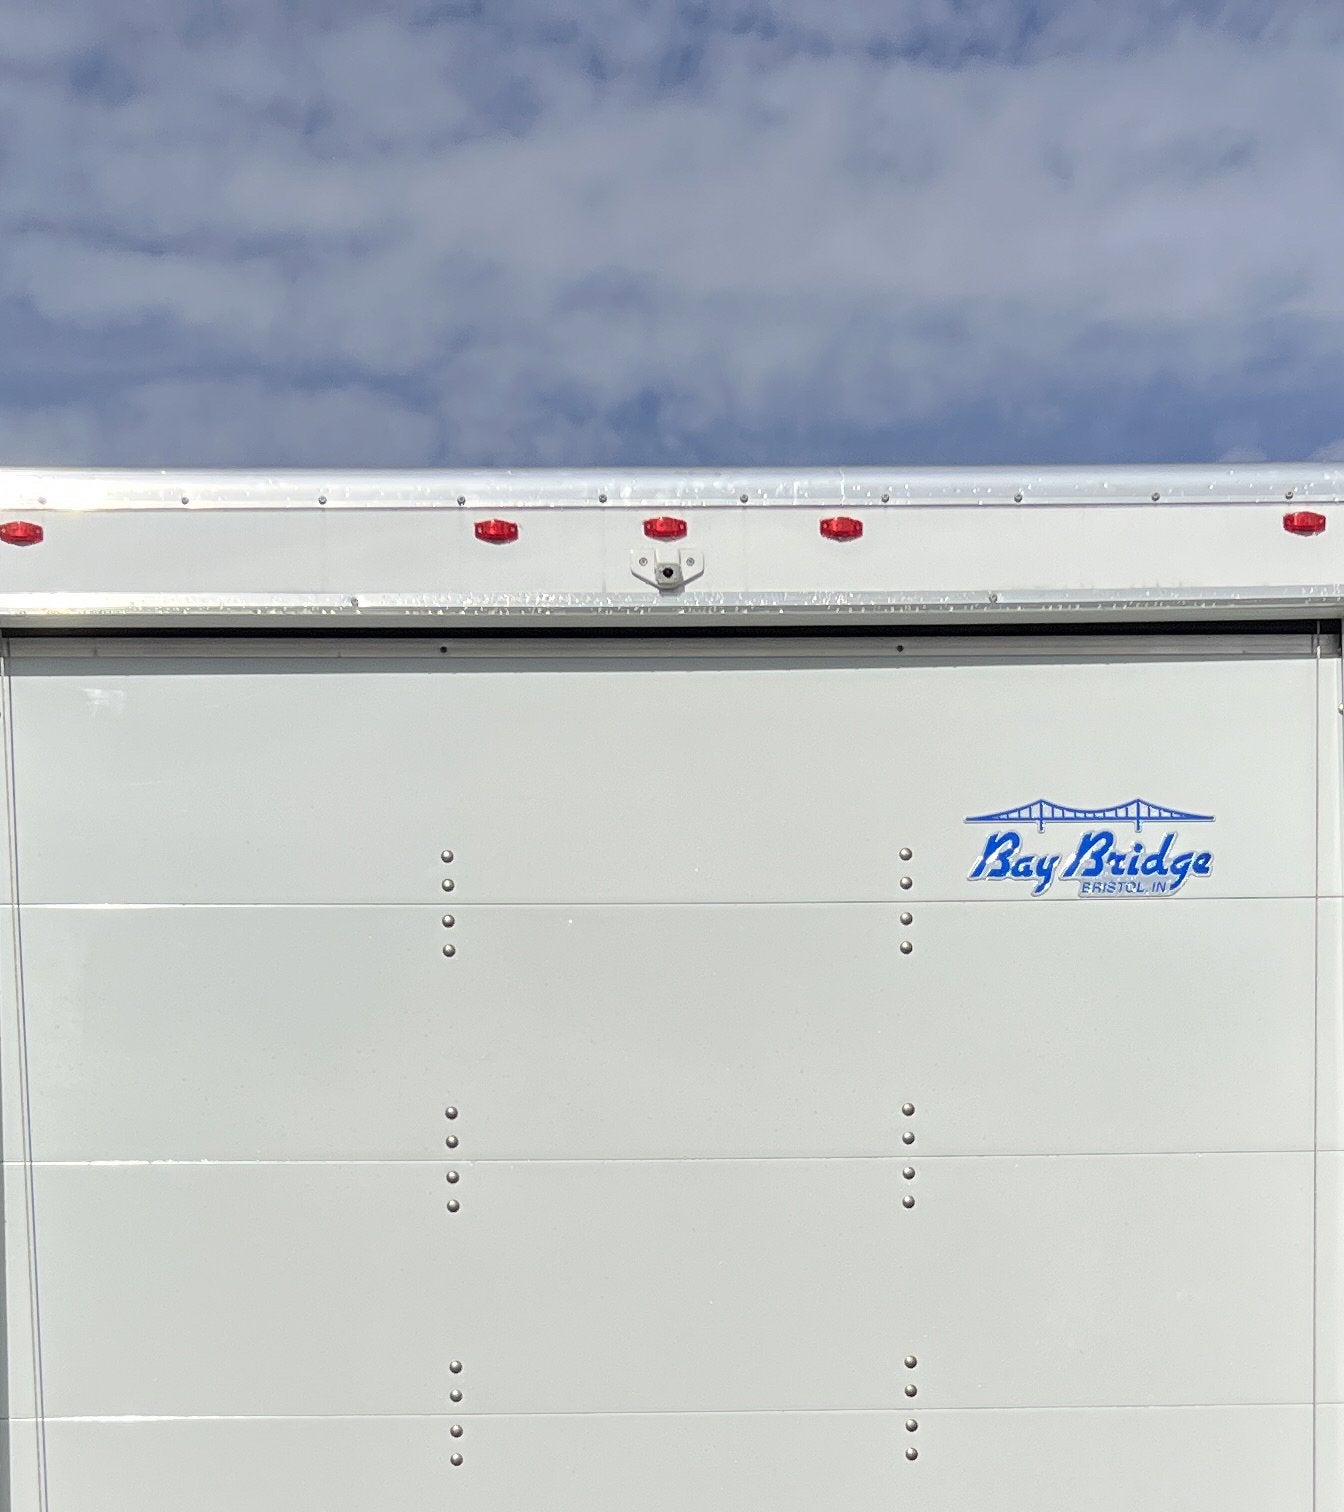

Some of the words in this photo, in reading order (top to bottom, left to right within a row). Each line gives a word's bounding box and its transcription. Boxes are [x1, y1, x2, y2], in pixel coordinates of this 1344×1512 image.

[970, 831, 1057, 893] Bay
[1060, 831, 1212, 890] Bridge
[1152, 881, 1166, 893] IN
